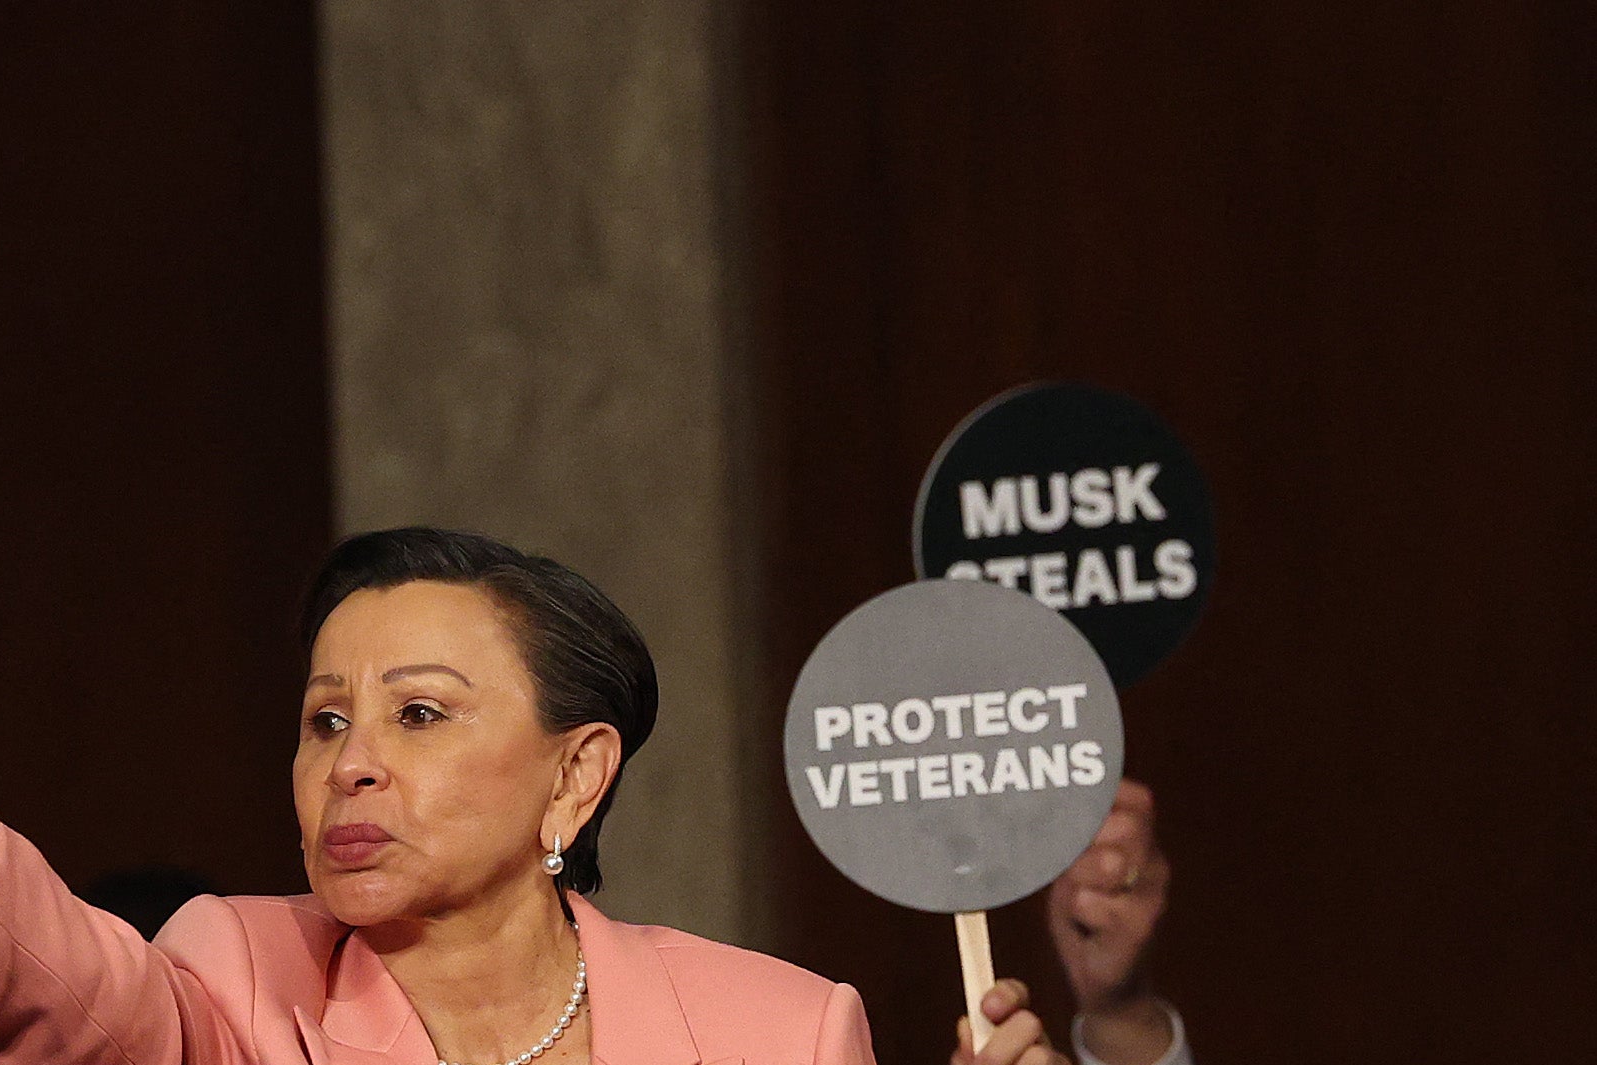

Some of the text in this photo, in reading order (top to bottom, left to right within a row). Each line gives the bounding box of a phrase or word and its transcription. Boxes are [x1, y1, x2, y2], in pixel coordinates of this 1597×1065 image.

[959, 463, 1167, 540] MUSK
[813, 683, 1088, 752] PROTECT
[805, 740, 1106, 809] VETERANS
